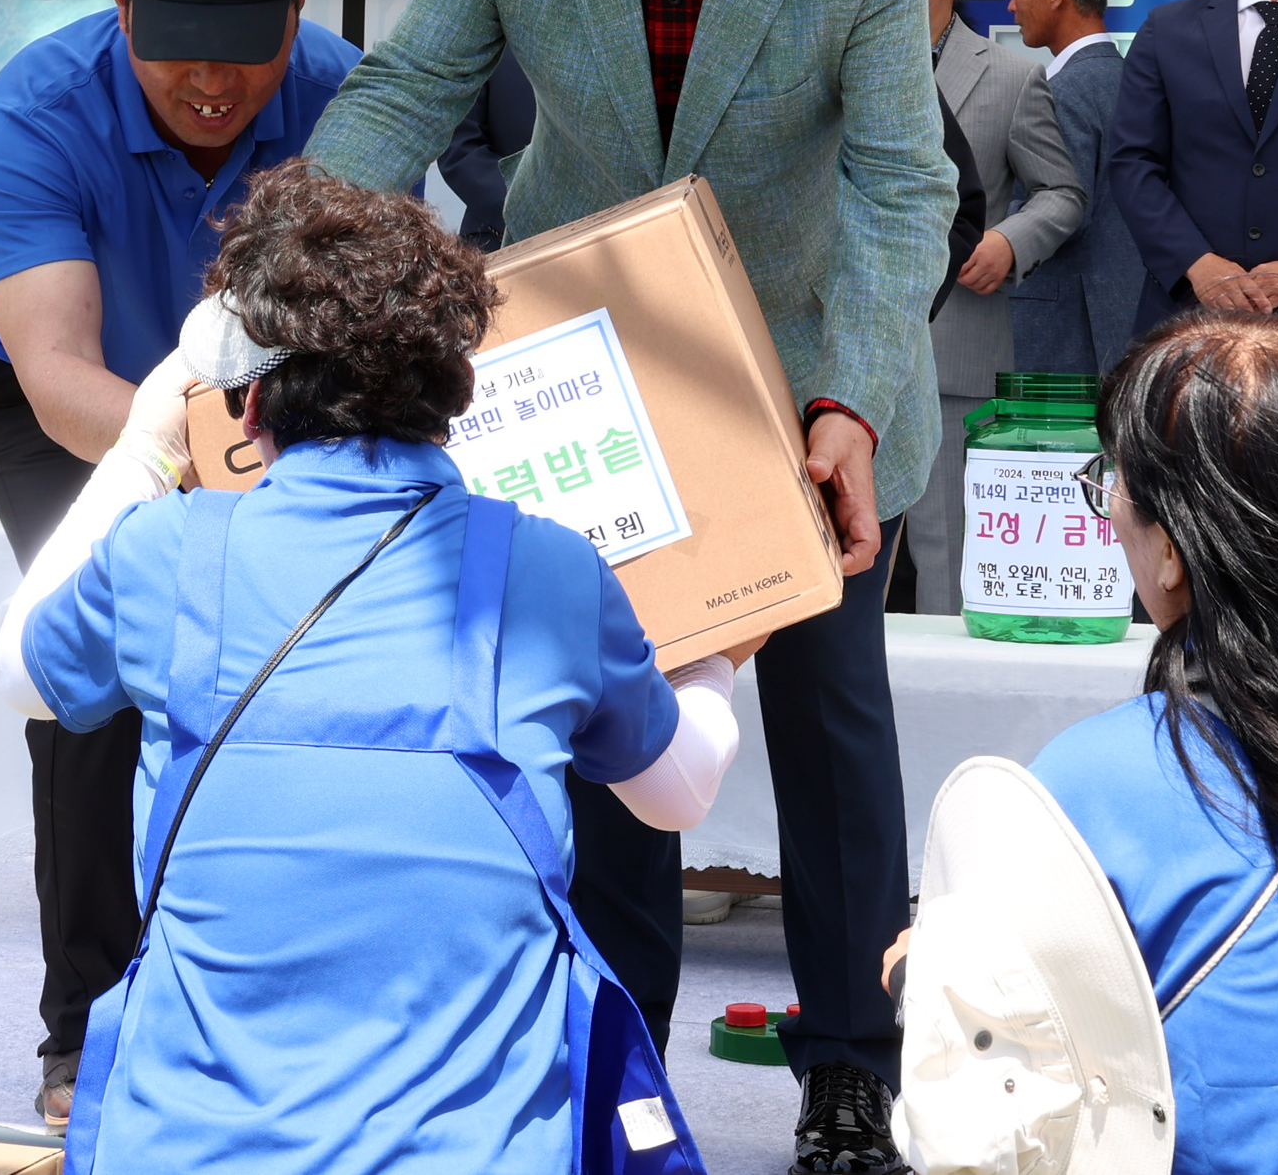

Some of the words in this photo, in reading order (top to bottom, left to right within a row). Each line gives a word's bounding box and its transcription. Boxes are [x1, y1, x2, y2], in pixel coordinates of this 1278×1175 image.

[481, 381, 498, 398] 날
[514, 370, 603, 421] 놀이마당
[467, 427, 644, 503] 력밥솥
[1031, 470, 1064, 481] 면민의
[1014, 485, 1076, 504] 고군면민
[976, 511, 1020, 545] 고성
[1062, 515, 1120, 547] 금계
[705, 589, 740, 610] MADE
[740, 584, 754, 597] IN
[754, 570, 793, 592] KOREA
[1092, 584, 1114, 601] 용호
